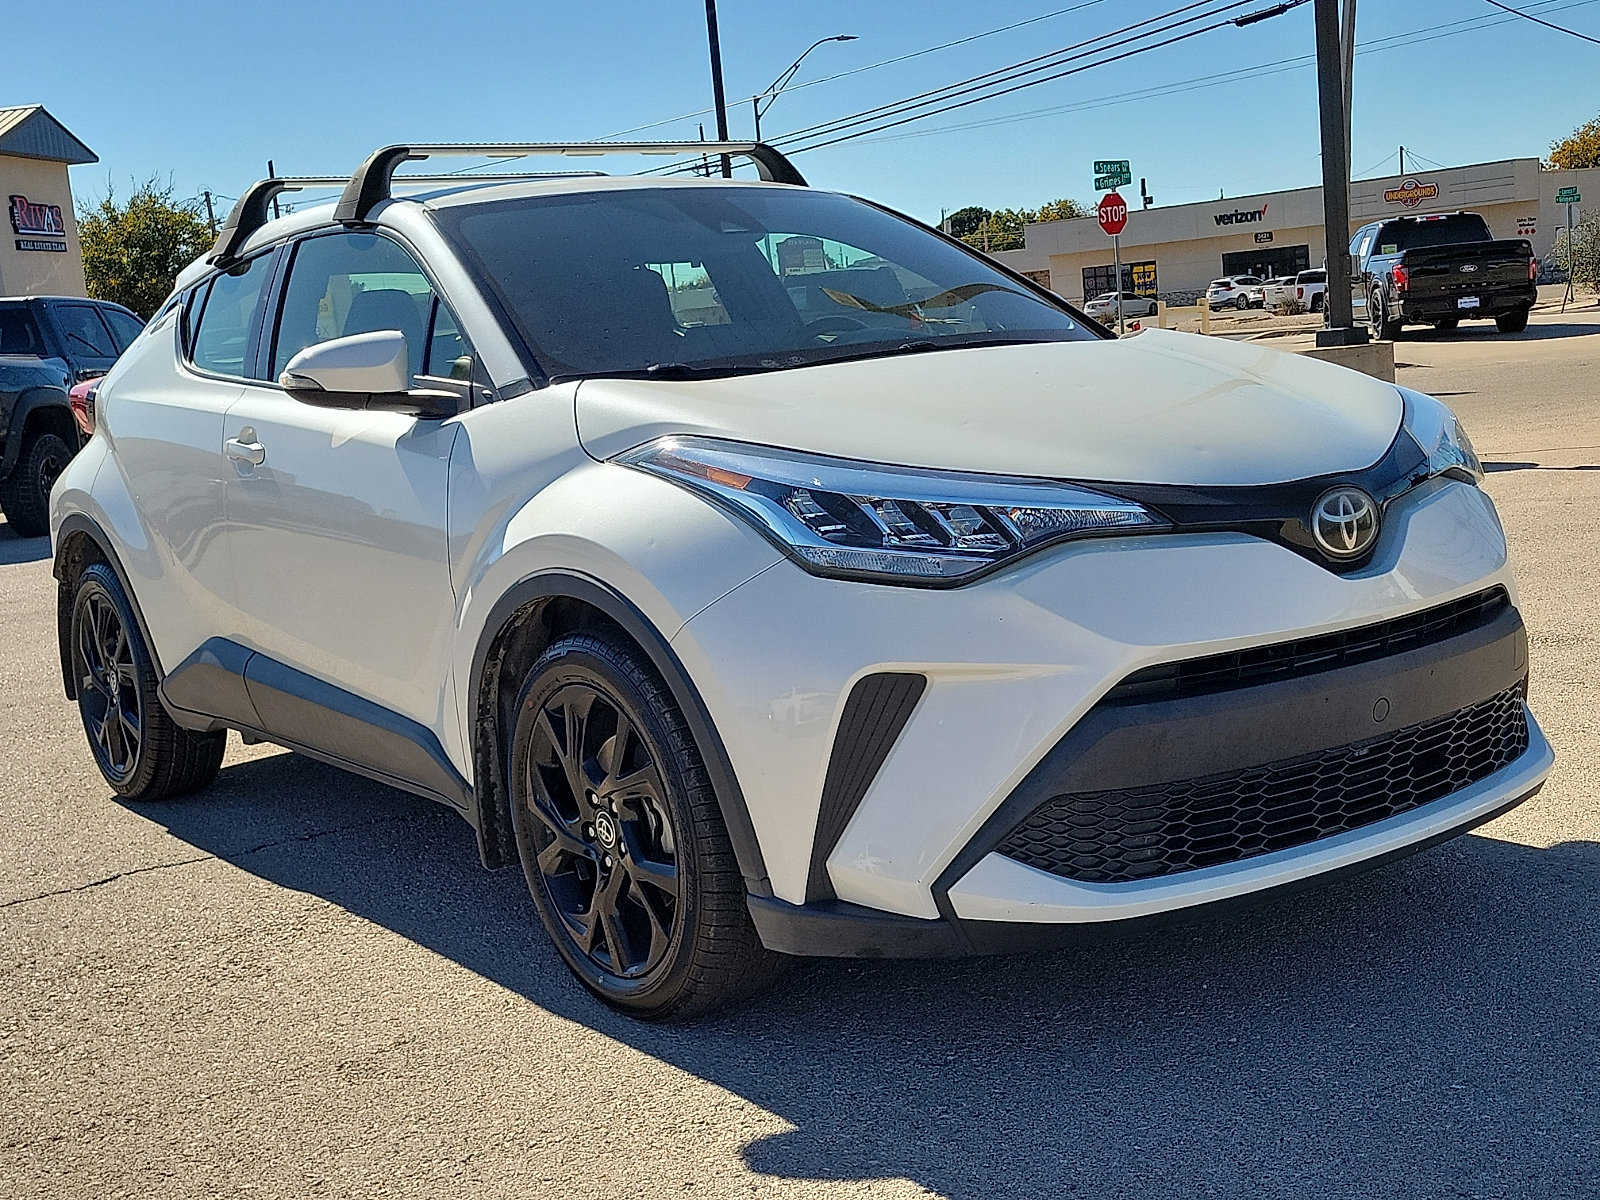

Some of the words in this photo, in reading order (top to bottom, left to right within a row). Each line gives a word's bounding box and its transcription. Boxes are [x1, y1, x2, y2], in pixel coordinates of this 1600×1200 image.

[1099, 162, 1121, 174] Spears
[1099, 177, 1121, 188] Grimes
[1385, 187, 1435, 200] UNDERGROUNDS
[1100, 205, 1125, 223] STOP
[1213, 209, 1263, 226] verizon
[20, 241, 34, 249] REAL
[34, 242, 52, 250] ESTATE
[52, 243, 66, 251] TEAM
[1460, 264, 1477, 272] Ford
